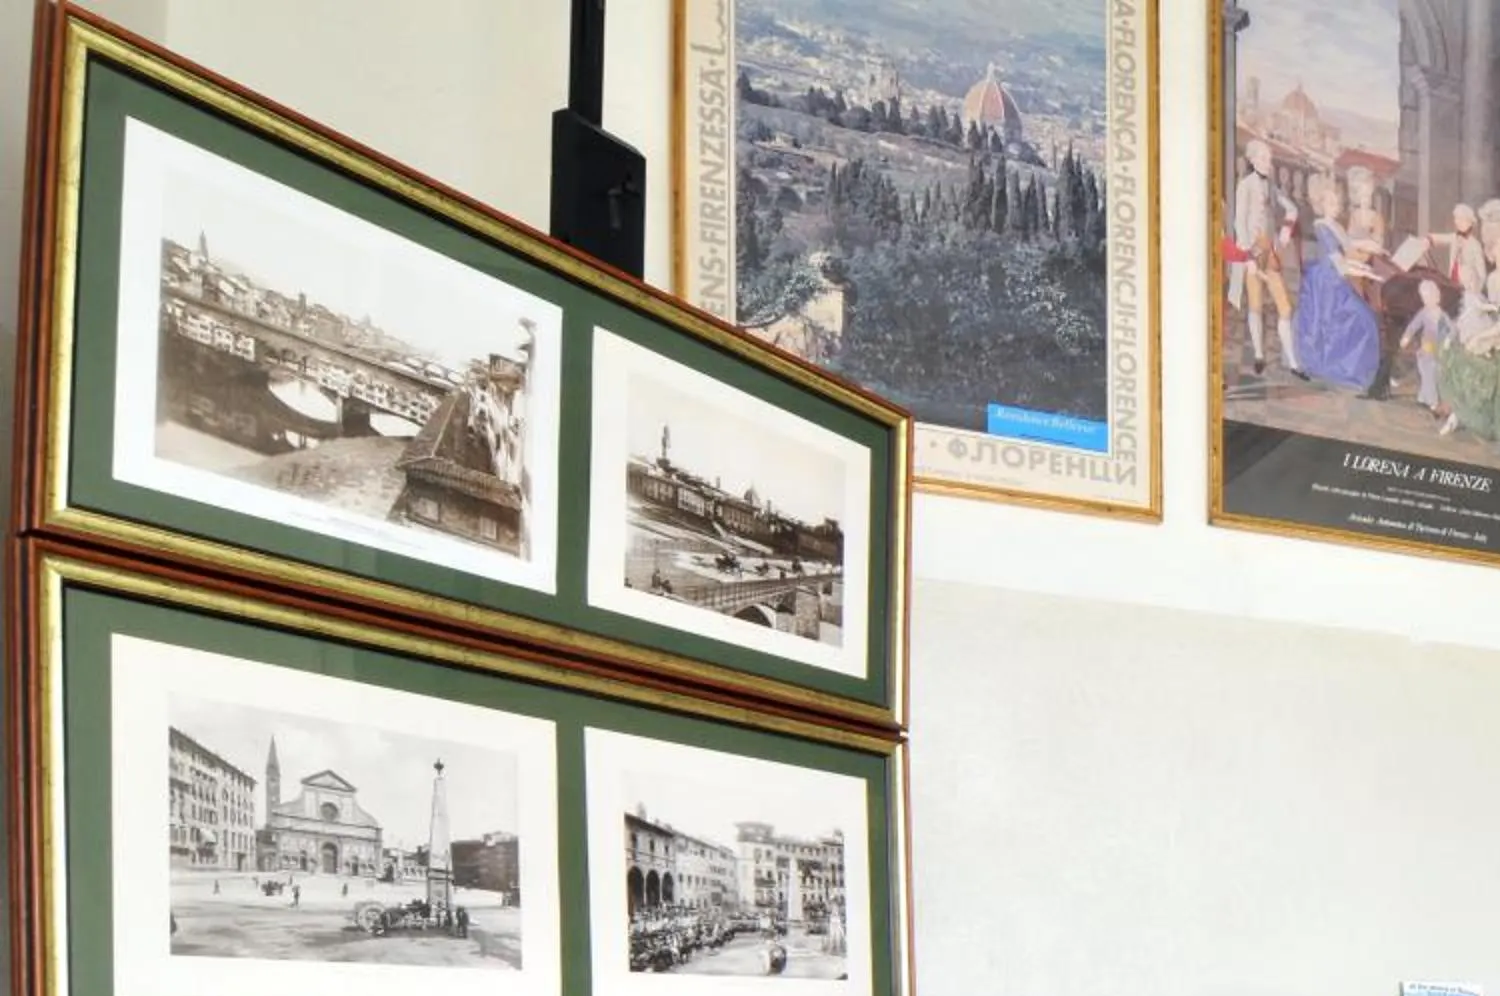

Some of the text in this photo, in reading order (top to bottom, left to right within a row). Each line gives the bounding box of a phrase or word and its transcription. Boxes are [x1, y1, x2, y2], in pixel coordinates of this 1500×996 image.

[1113, 173, 1137, 318] FLORENCJI
[1351, 455, 1411, 478] LORENA
[1413, 467, 1426, 481] A
[1428, 467, 1493, 493] FIRENZE
